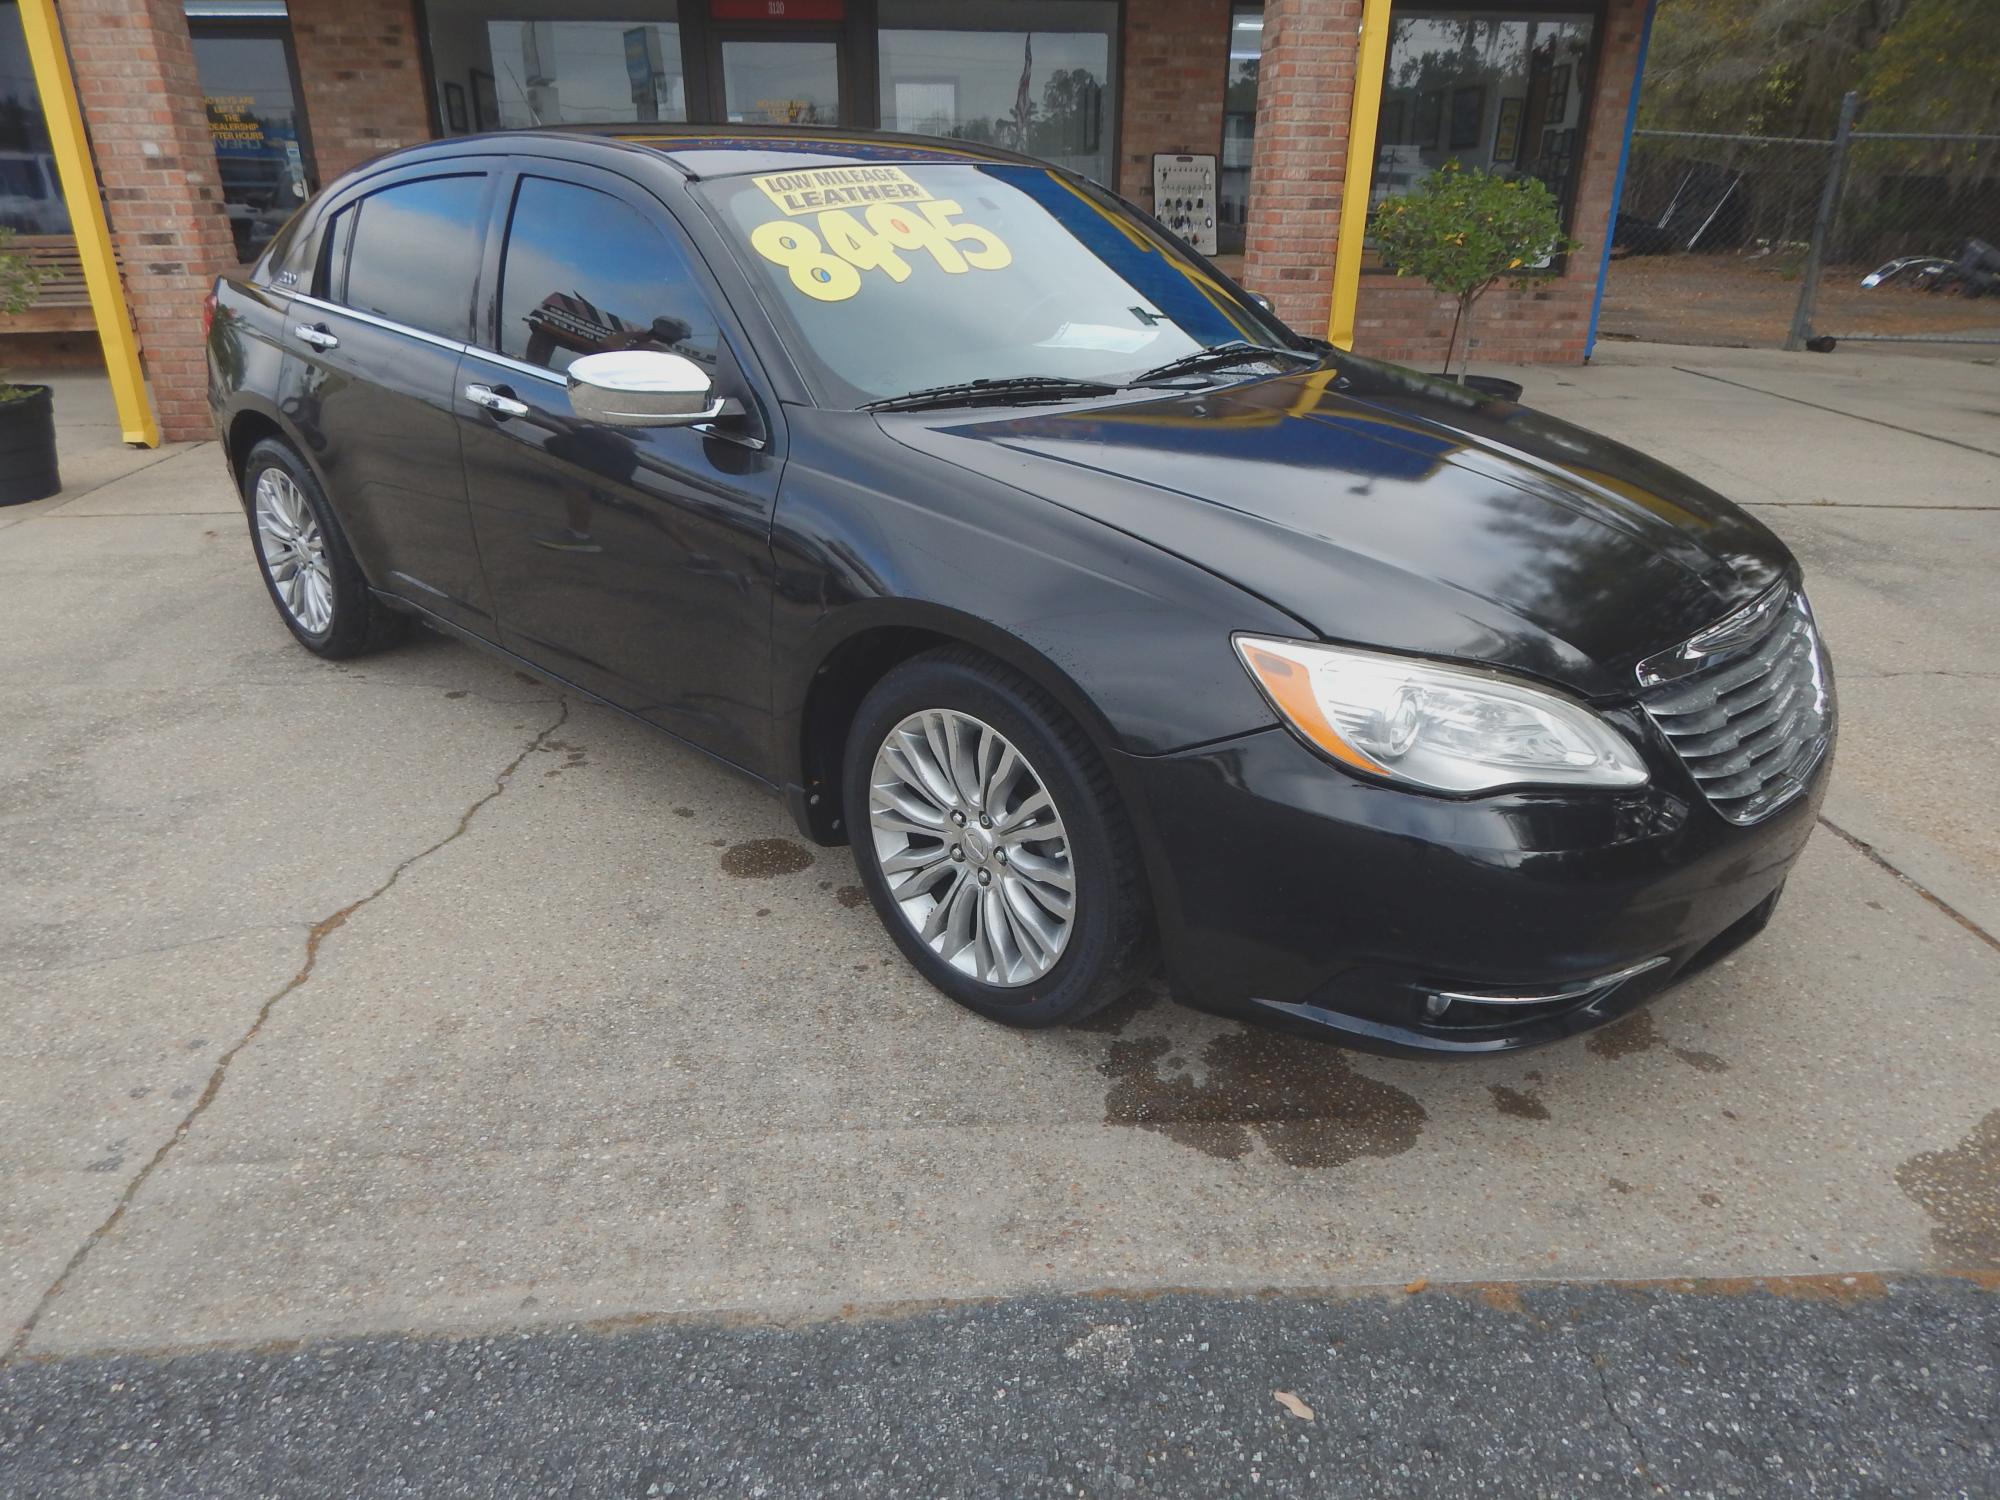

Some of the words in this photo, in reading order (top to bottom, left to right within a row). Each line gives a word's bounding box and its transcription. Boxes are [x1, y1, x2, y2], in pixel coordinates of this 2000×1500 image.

[768, 1, 785, 15] 3120
[224, 114, 240, 122] THE
[208, 123, 258, 132] DEALERSHIP
[237, 131, 264, 140] HOURS
[765, 172, 811, 194] LOW
[815, 167, 899, 187] MILEAGE
[783, 183, 920, 210] LEATHER
[751, 198, 1013, 302] 8495
